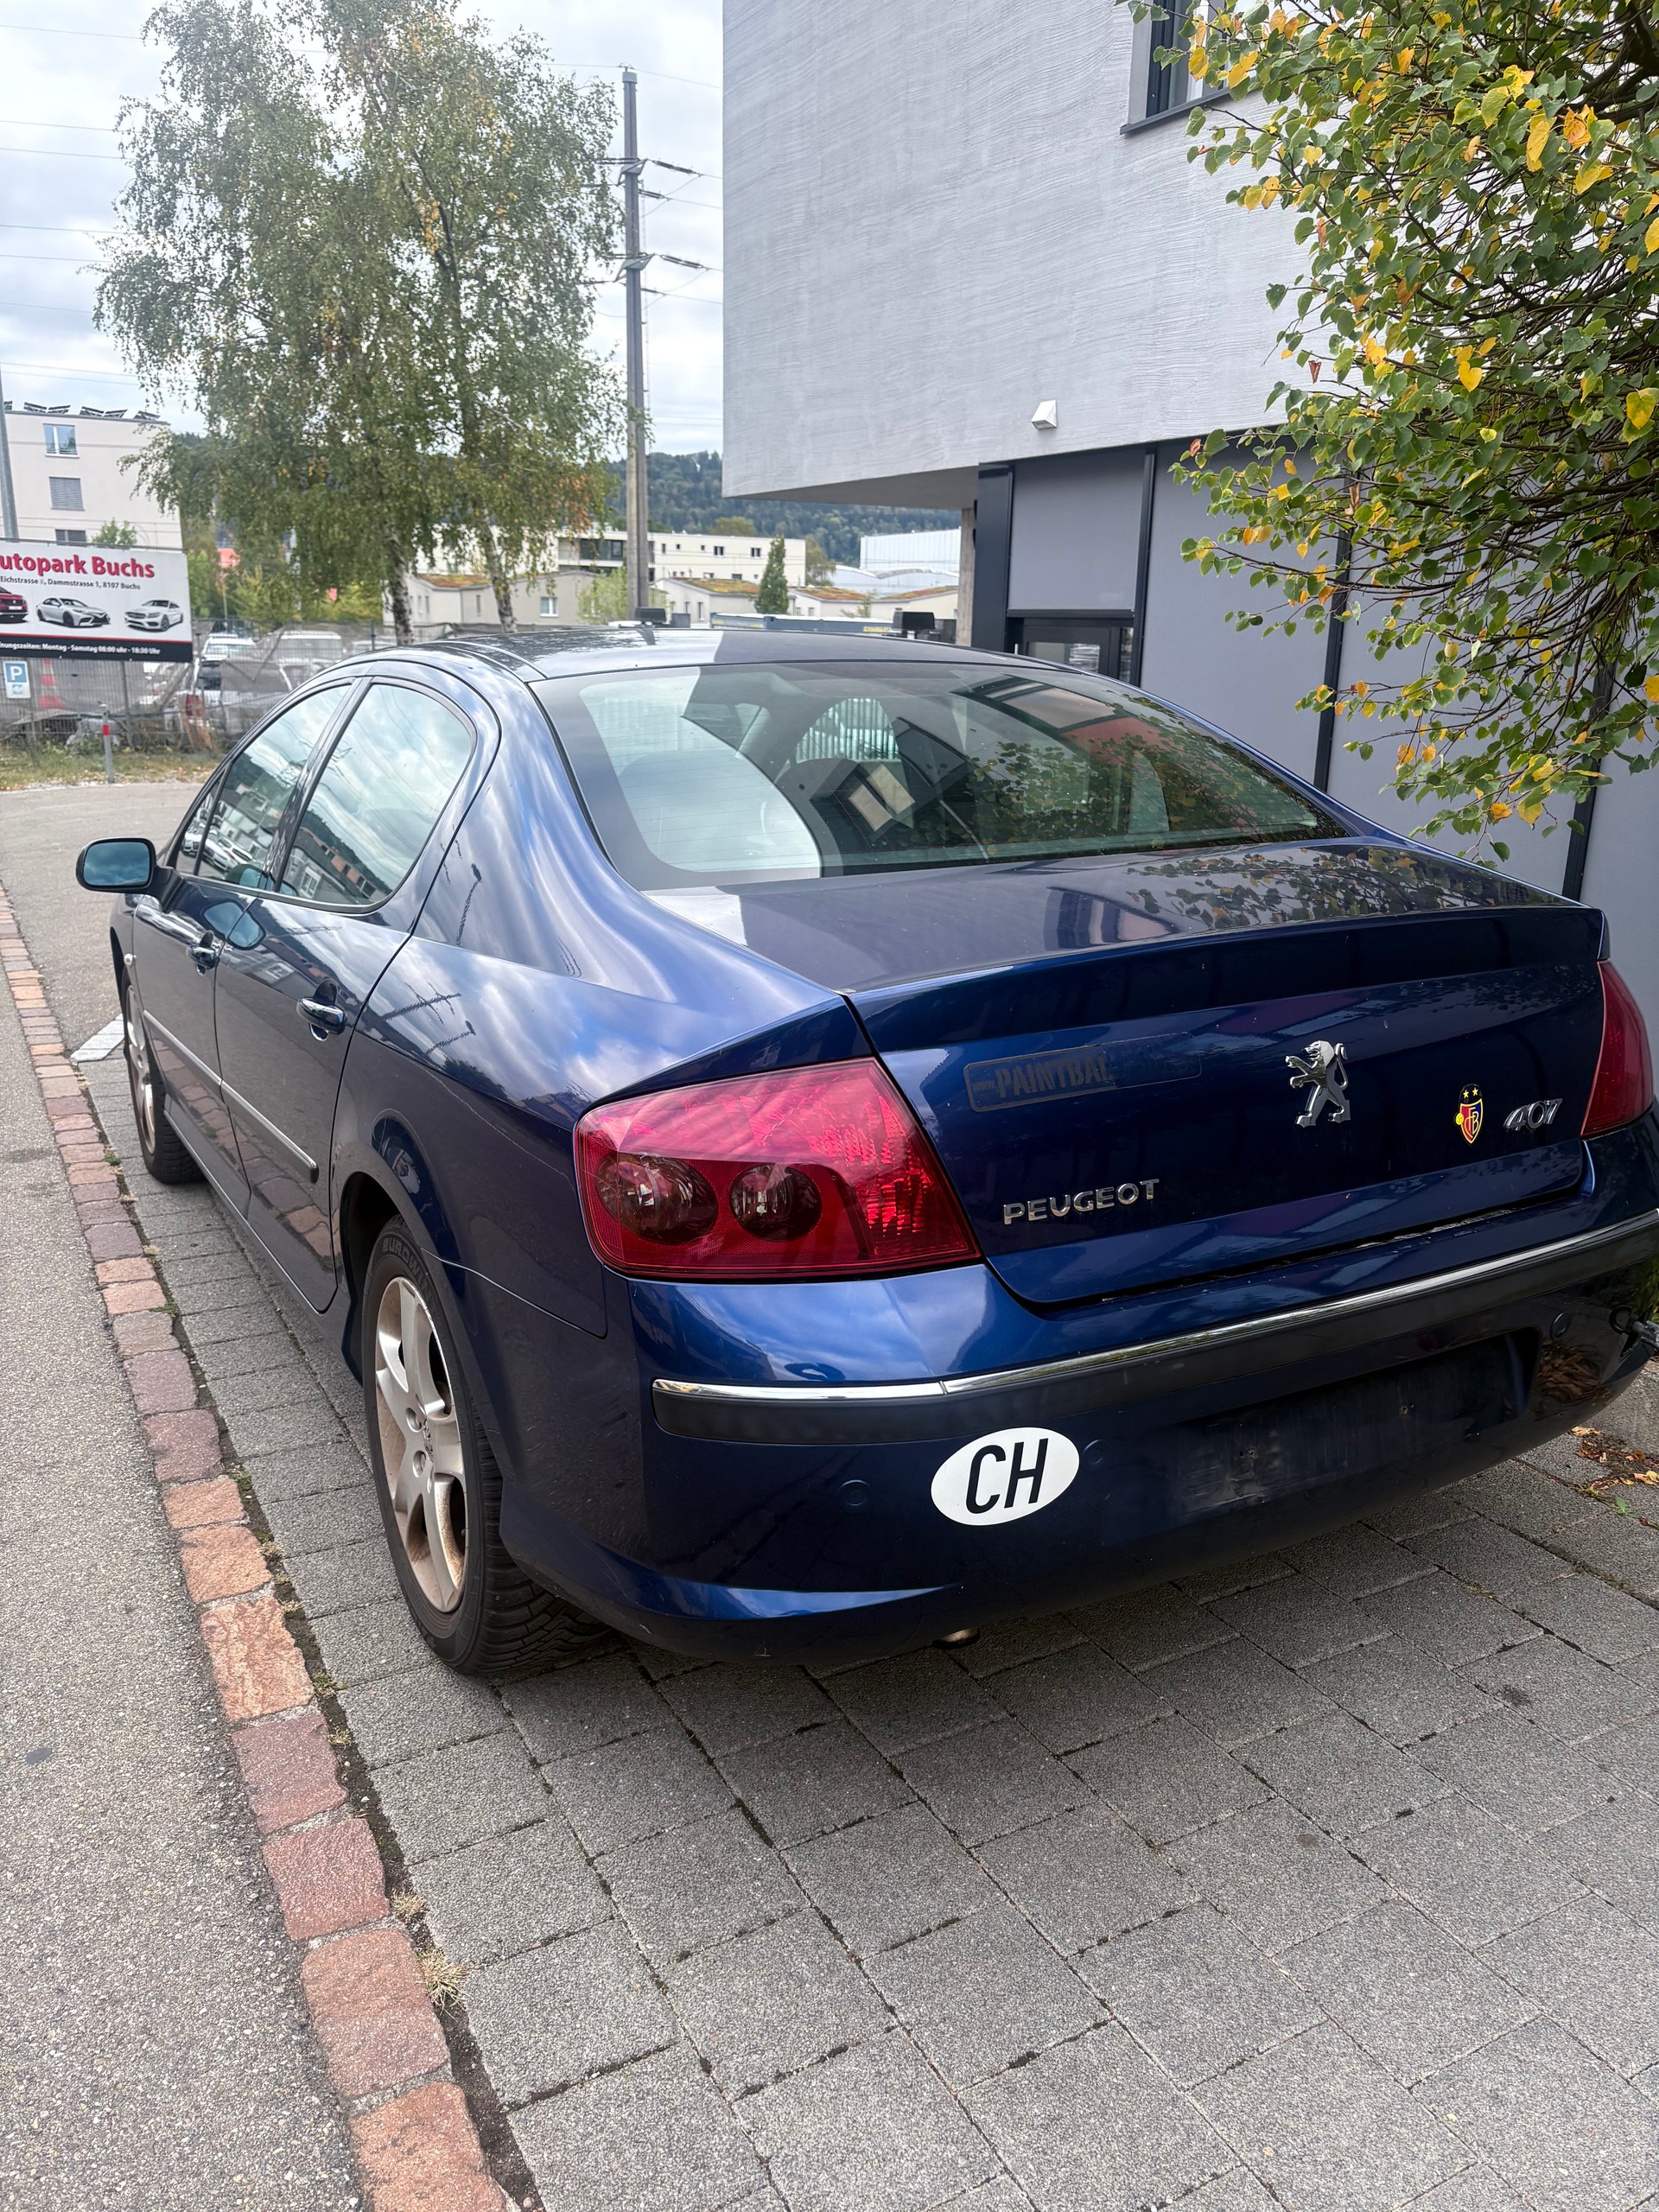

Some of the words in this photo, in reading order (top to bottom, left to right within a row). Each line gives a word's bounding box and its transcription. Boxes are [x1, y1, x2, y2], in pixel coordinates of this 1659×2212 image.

[0, 553, 88, 577] utopark
[92, 556, 155, 578] Buchs
[0, 575, 38, 585] Eichstrasse
[48, 578, 93, 588] Dammstrasse
[0, 642, 41, 651] nungszeiten:
[41, 643, 67, 652] Montag
[70, 644, 98, 654] Samstag
[10, 665, 23, 681] P
[1503, 1098, 1563, 1131] 407
[1002, 1179, 1160, 1225] PEUGEOT
[965, 1438, 1049, 1515] CH
